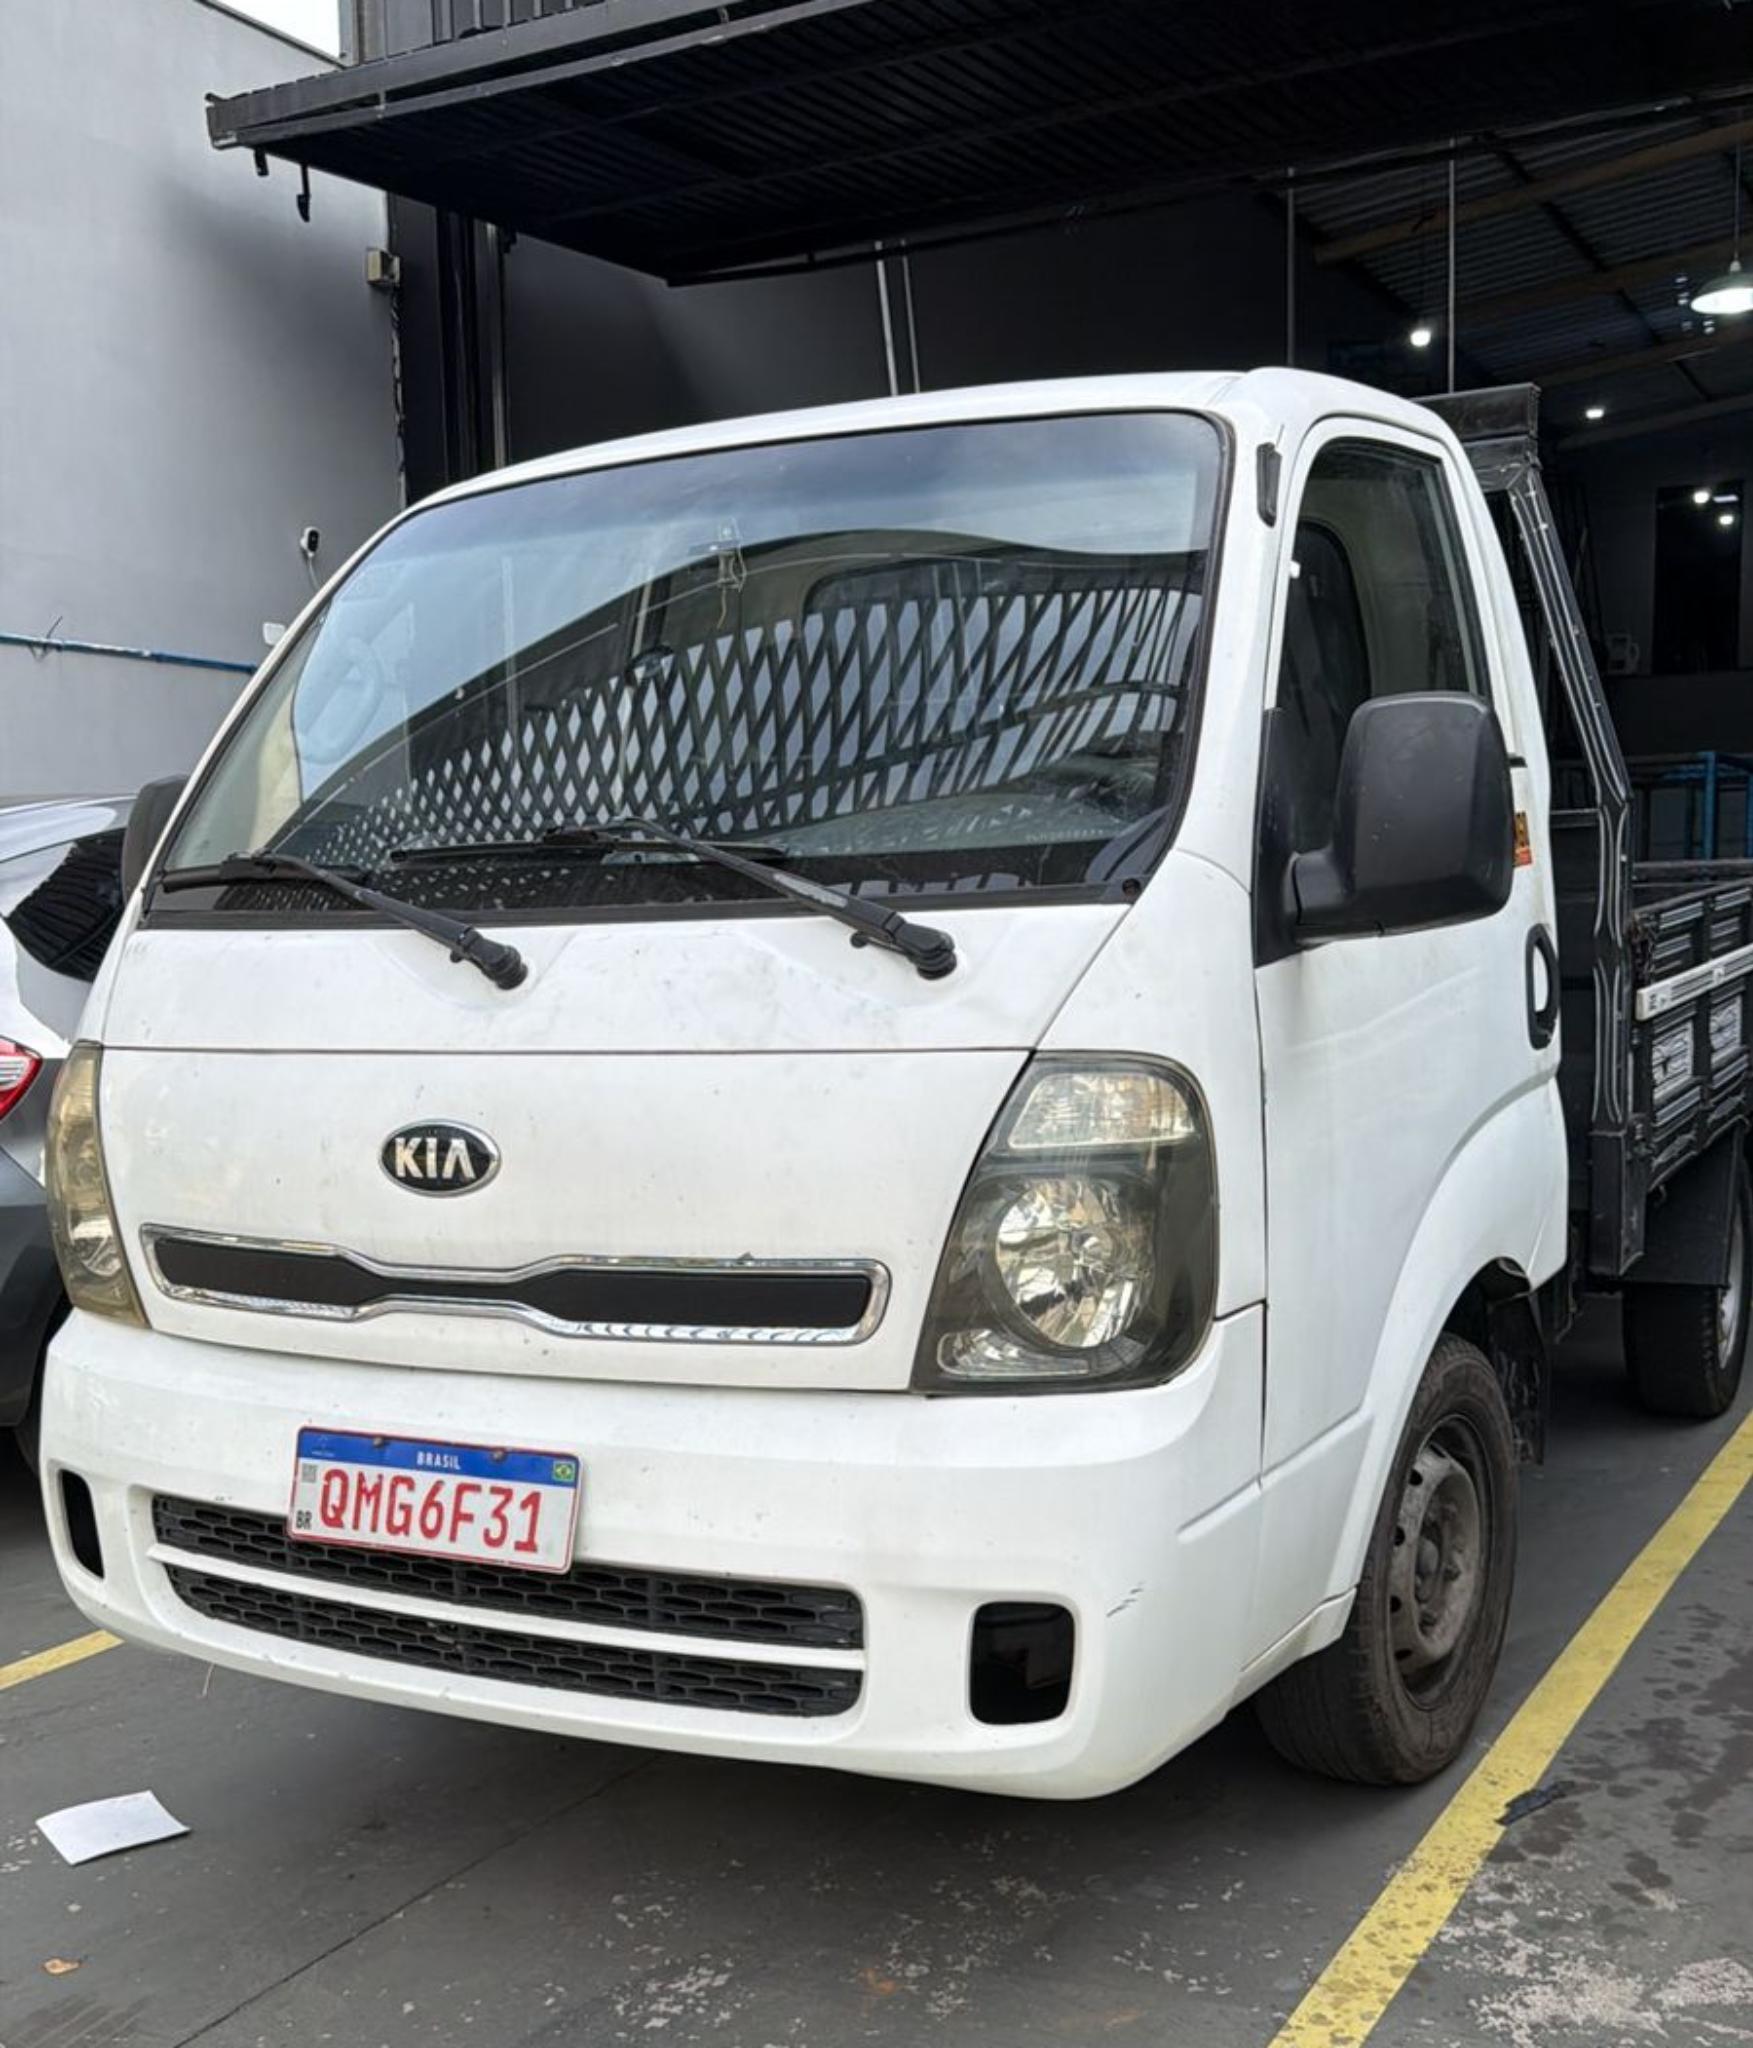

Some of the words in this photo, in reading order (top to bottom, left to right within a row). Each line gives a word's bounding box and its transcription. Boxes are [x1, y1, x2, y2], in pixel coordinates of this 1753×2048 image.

[394, 1137, 476, 1179] KIA
[416, 1451, 461, 1470] BRASIL
[296, 1509, 312, 1530] BR
[319, 1468, 543, 1553] QMG6F31
